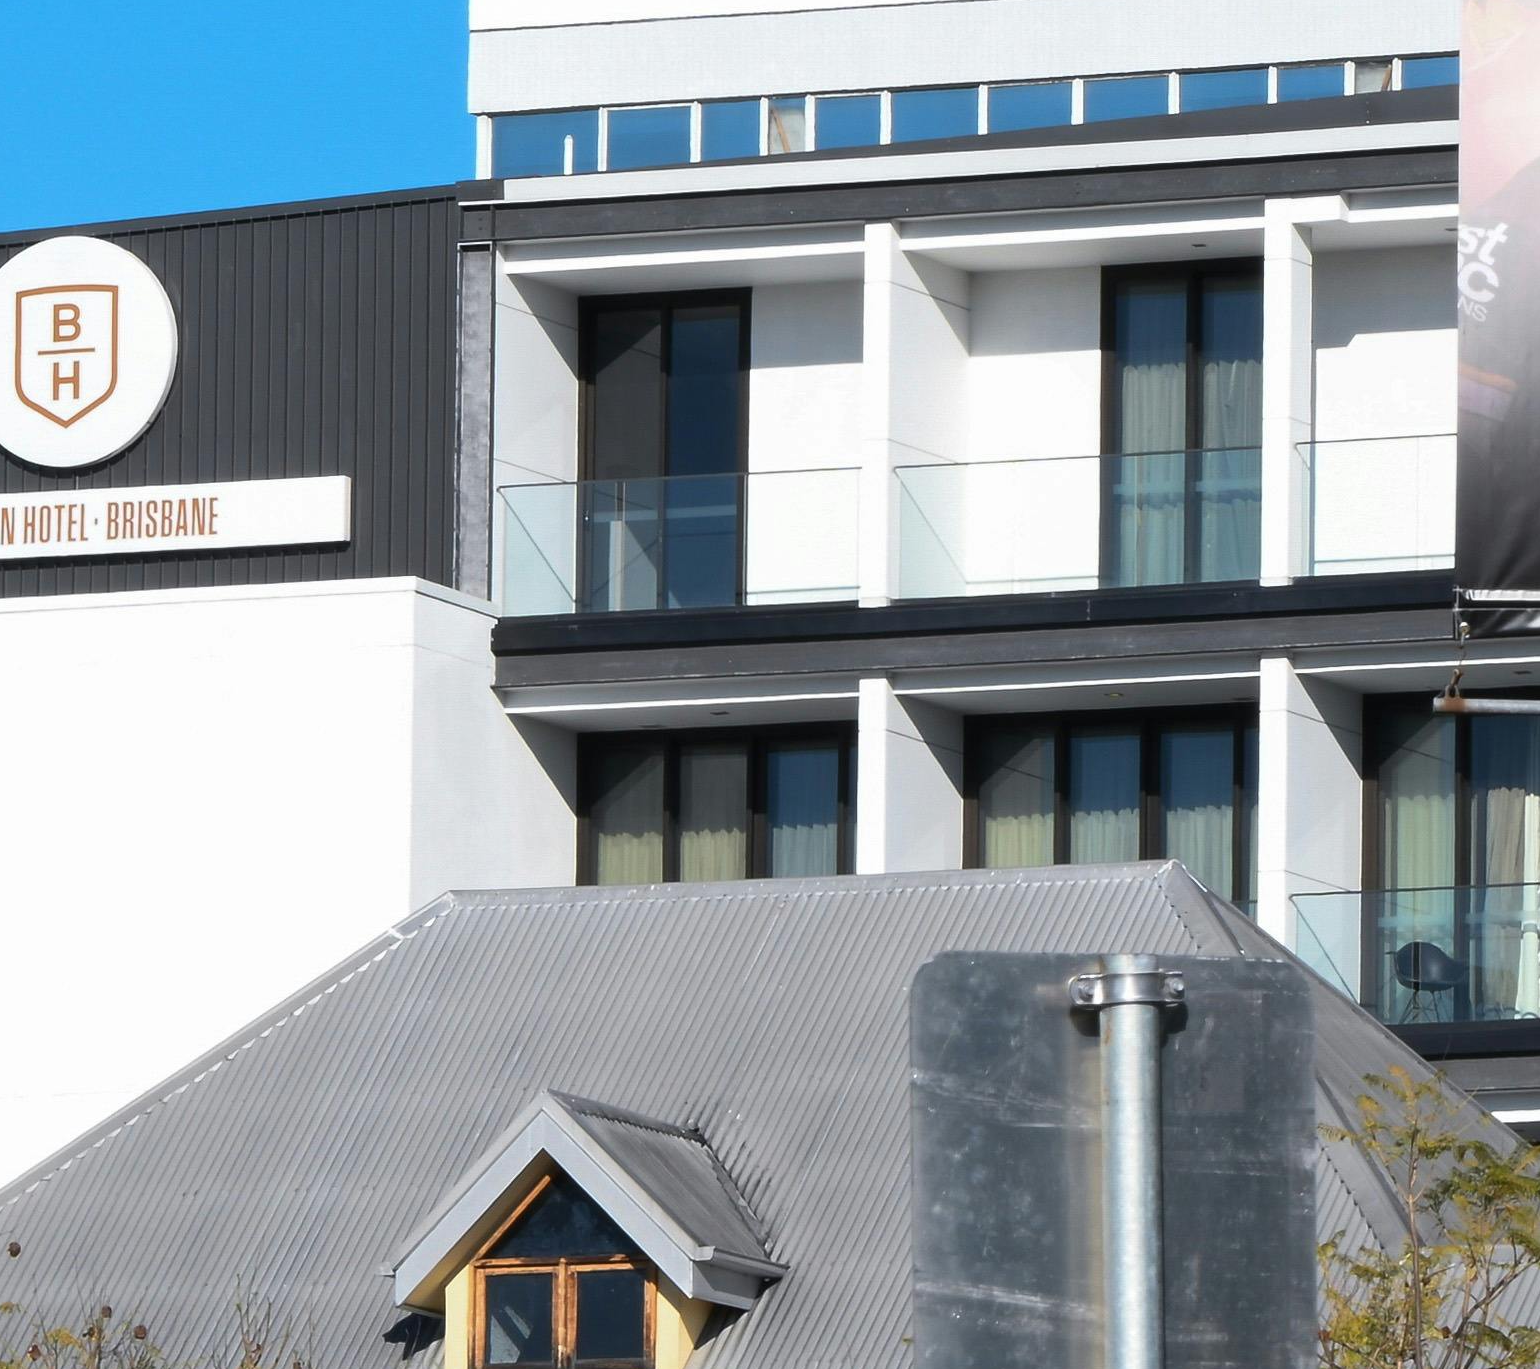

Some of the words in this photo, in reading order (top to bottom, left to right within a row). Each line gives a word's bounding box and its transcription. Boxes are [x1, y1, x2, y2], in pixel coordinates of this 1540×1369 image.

[53, 303, 81, 343] B
[53, 360, 81, 401] H
[24, 502, 89, 546] HOTEL
[106, 496, 220, 542] BRISBANE
